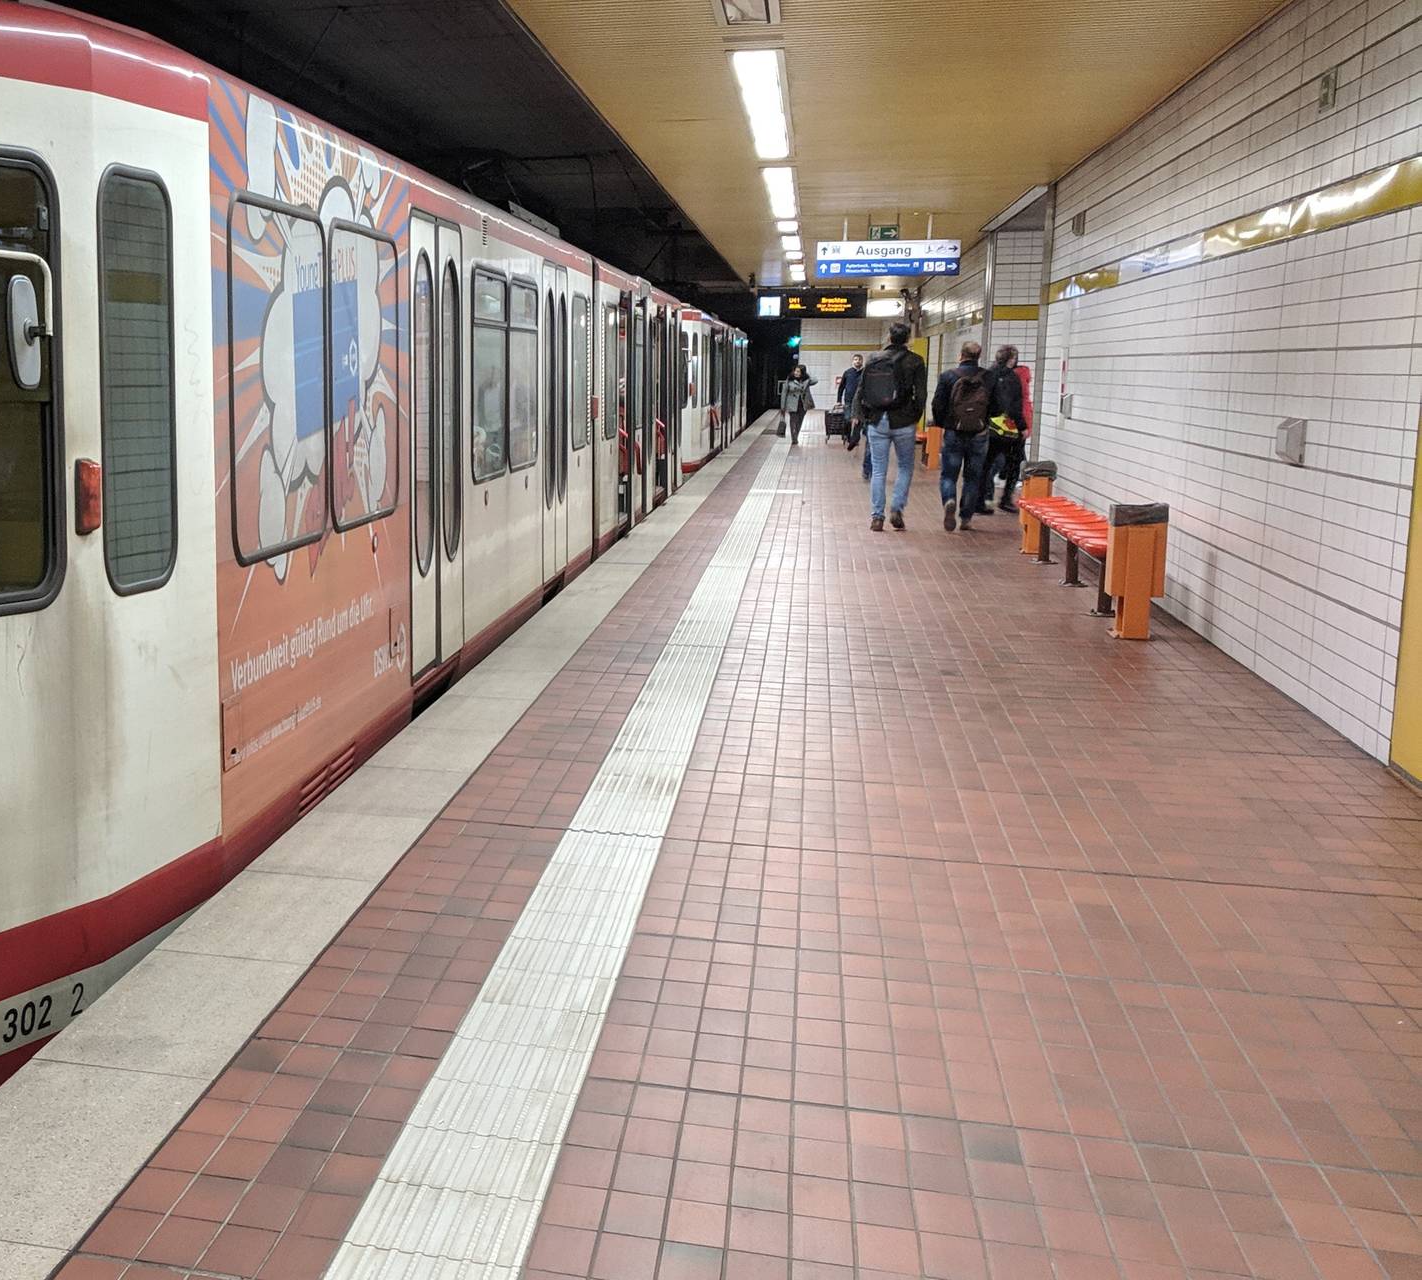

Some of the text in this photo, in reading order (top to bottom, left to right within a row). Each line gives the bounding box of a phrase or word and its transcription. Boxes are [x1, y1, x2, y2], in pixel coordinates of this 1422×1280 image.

[855, 245, 912, 258] Ausgang
[230, 635, 289, 692] Verbundweit
[290, 623, 316, 668] gültig!
[317, 609, 336, 644] Rund
[337, 612, 349, 633] um
[349, 599, 360, 627] die
[3, 982, 84, 1043] 302 2
